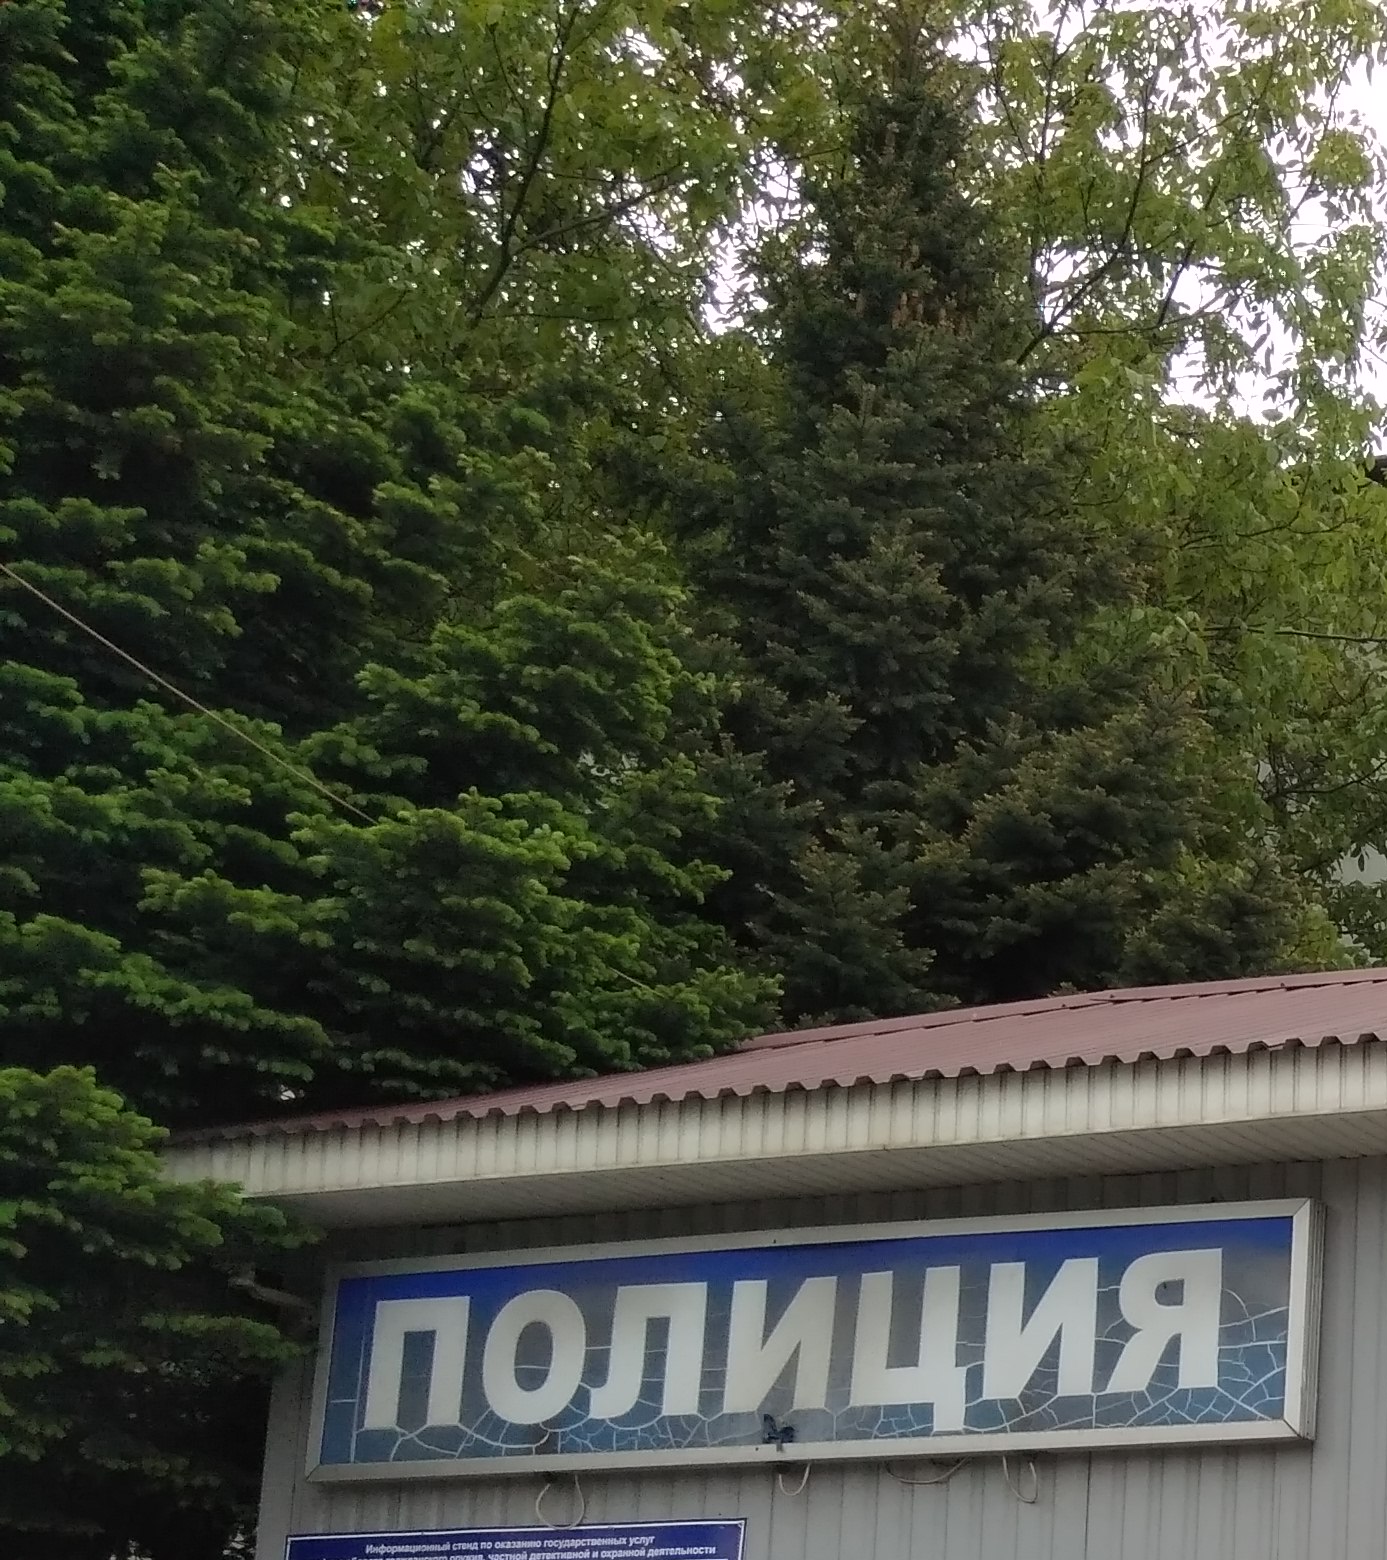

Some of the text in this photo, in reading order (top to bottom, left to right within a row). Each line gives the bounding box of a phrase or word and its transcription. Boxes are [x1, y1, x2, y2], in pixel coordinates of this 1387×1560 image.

[363, 1248, 1225, 1432] ПОЛИЦИЯ
[366, 1537, 656, 1554] Информационный стенд по оказанию государственных услуг
[600, 1547, 645, 1560] охранной
[647, 1547, 716, 1558] деятельности
